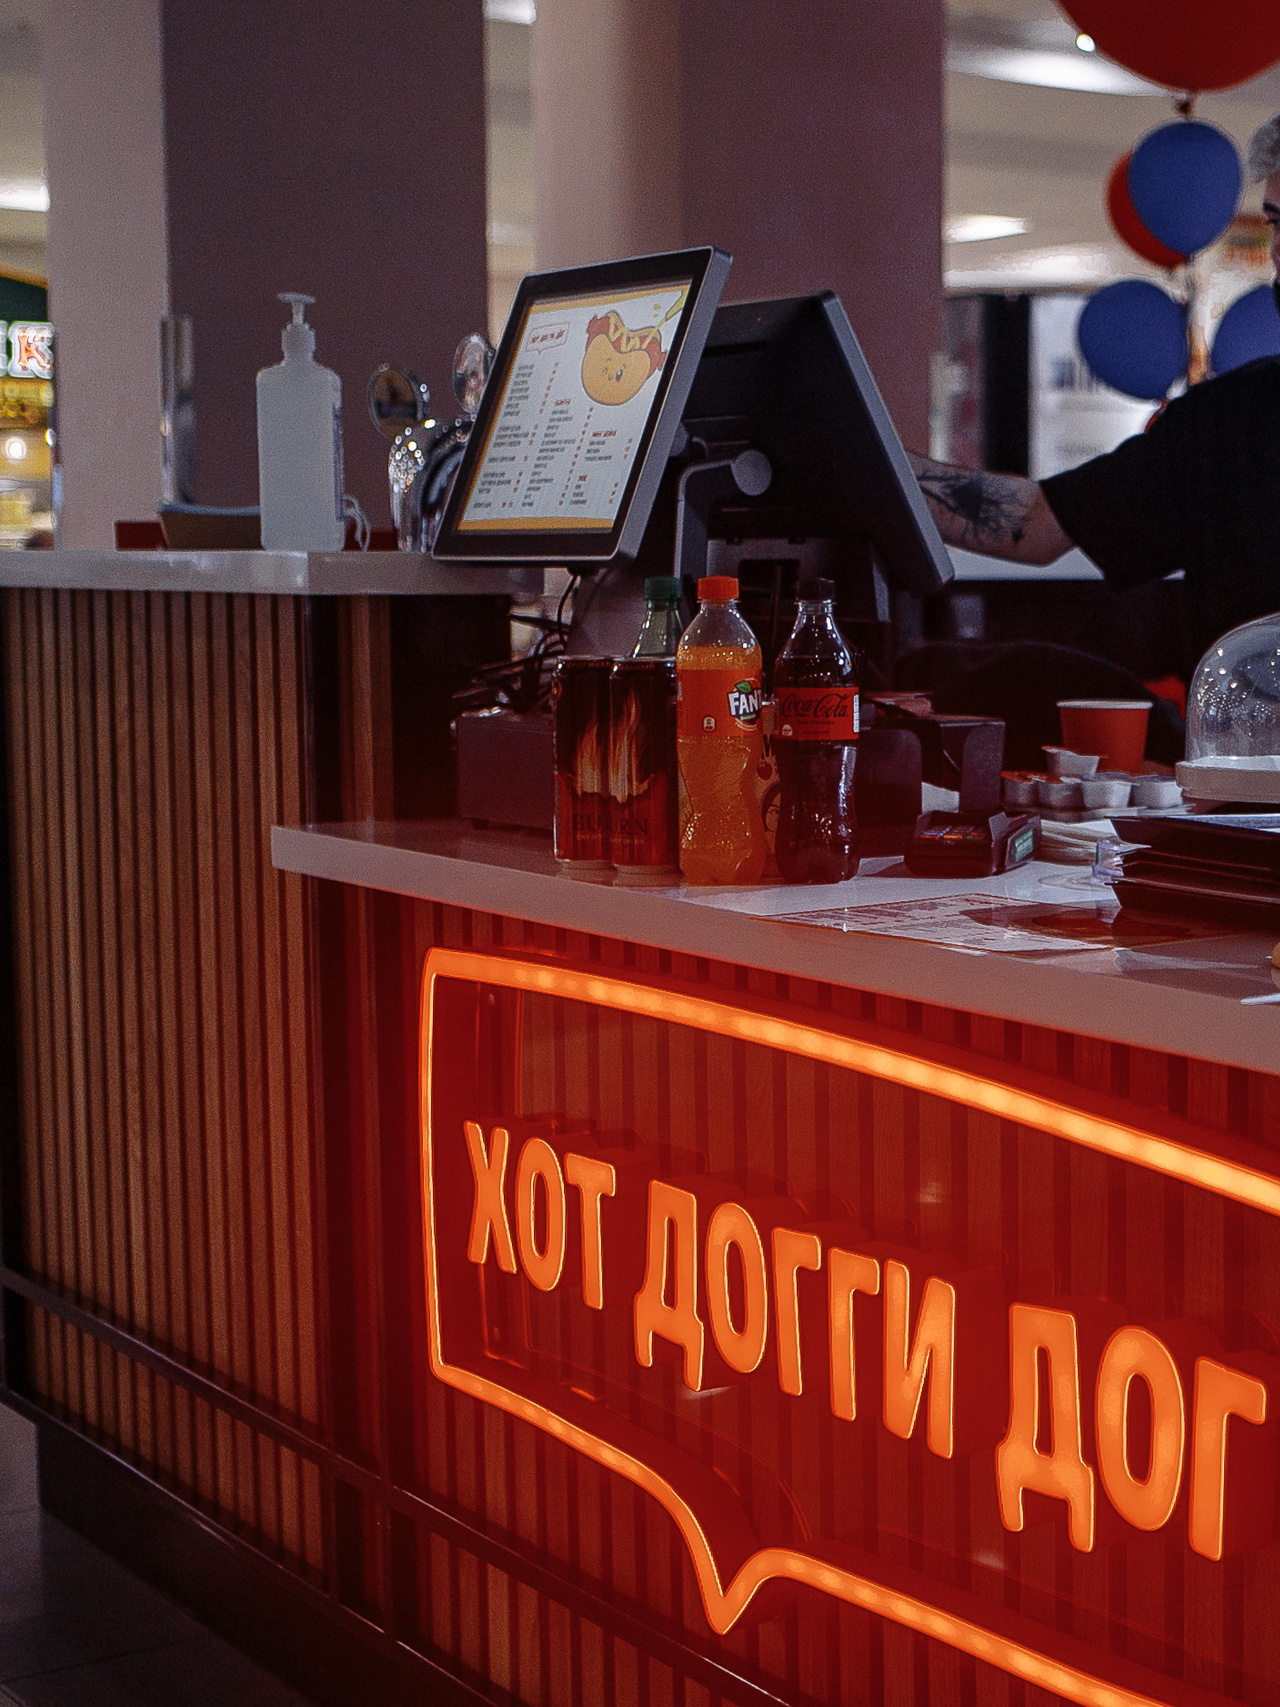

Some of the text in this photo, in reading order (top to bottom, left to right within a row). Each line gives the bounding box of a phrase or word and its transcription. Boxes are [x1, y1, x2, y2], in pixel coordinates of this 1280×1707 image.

[465, 1120, 1268, 1562] ХОТ ДОГГИ ДОГ
